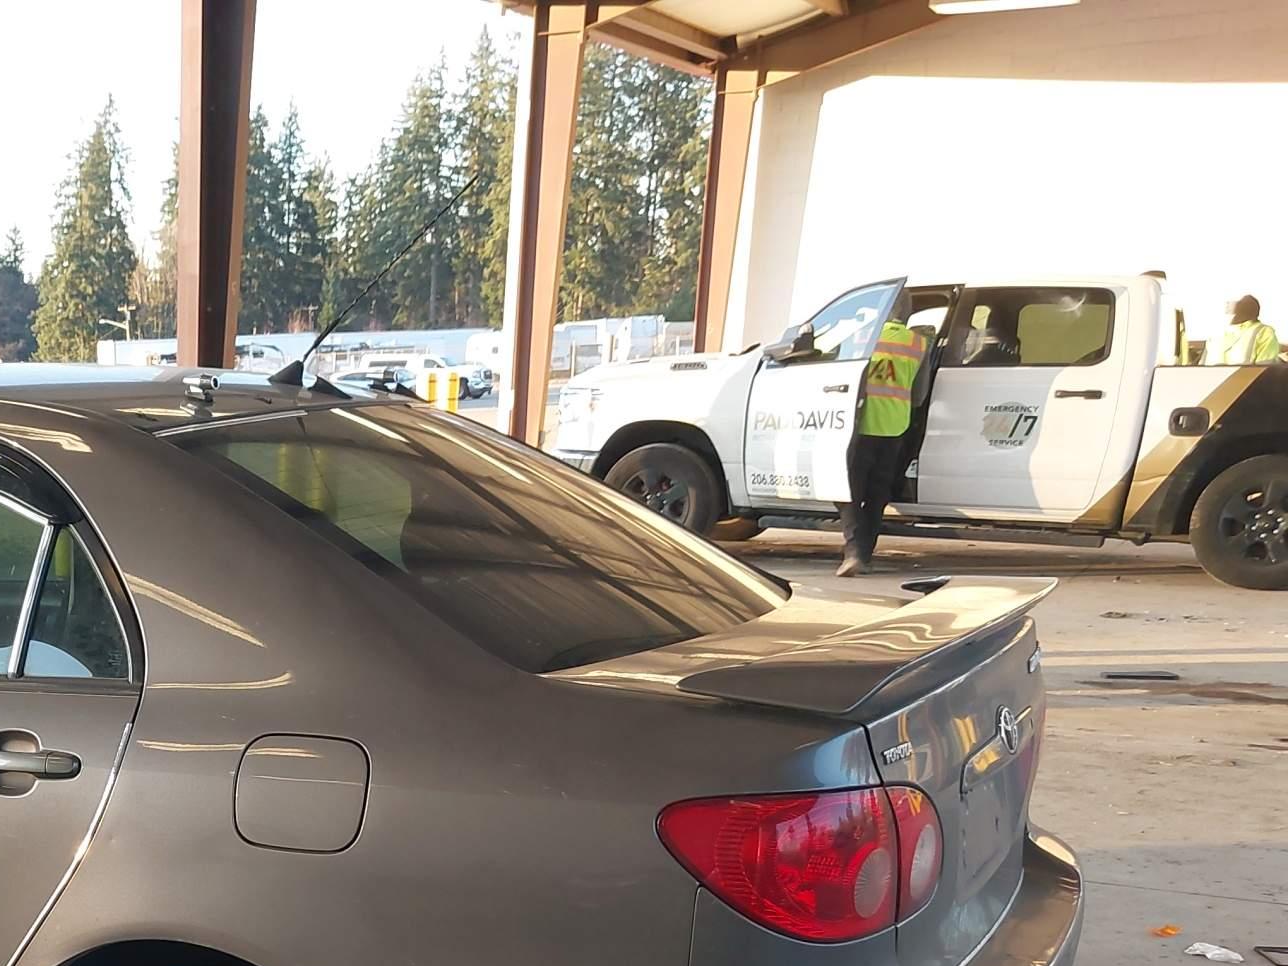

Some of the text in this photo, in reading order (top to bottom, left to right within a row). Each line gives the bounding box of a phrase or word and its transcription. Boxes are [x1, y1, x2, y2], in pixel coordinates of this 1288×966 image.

[984, 405, 1039, 413] EMERGENCY
[988, 439, 1025, 447] SERVICE
[883, 741, 913, 765] TOYOTA
